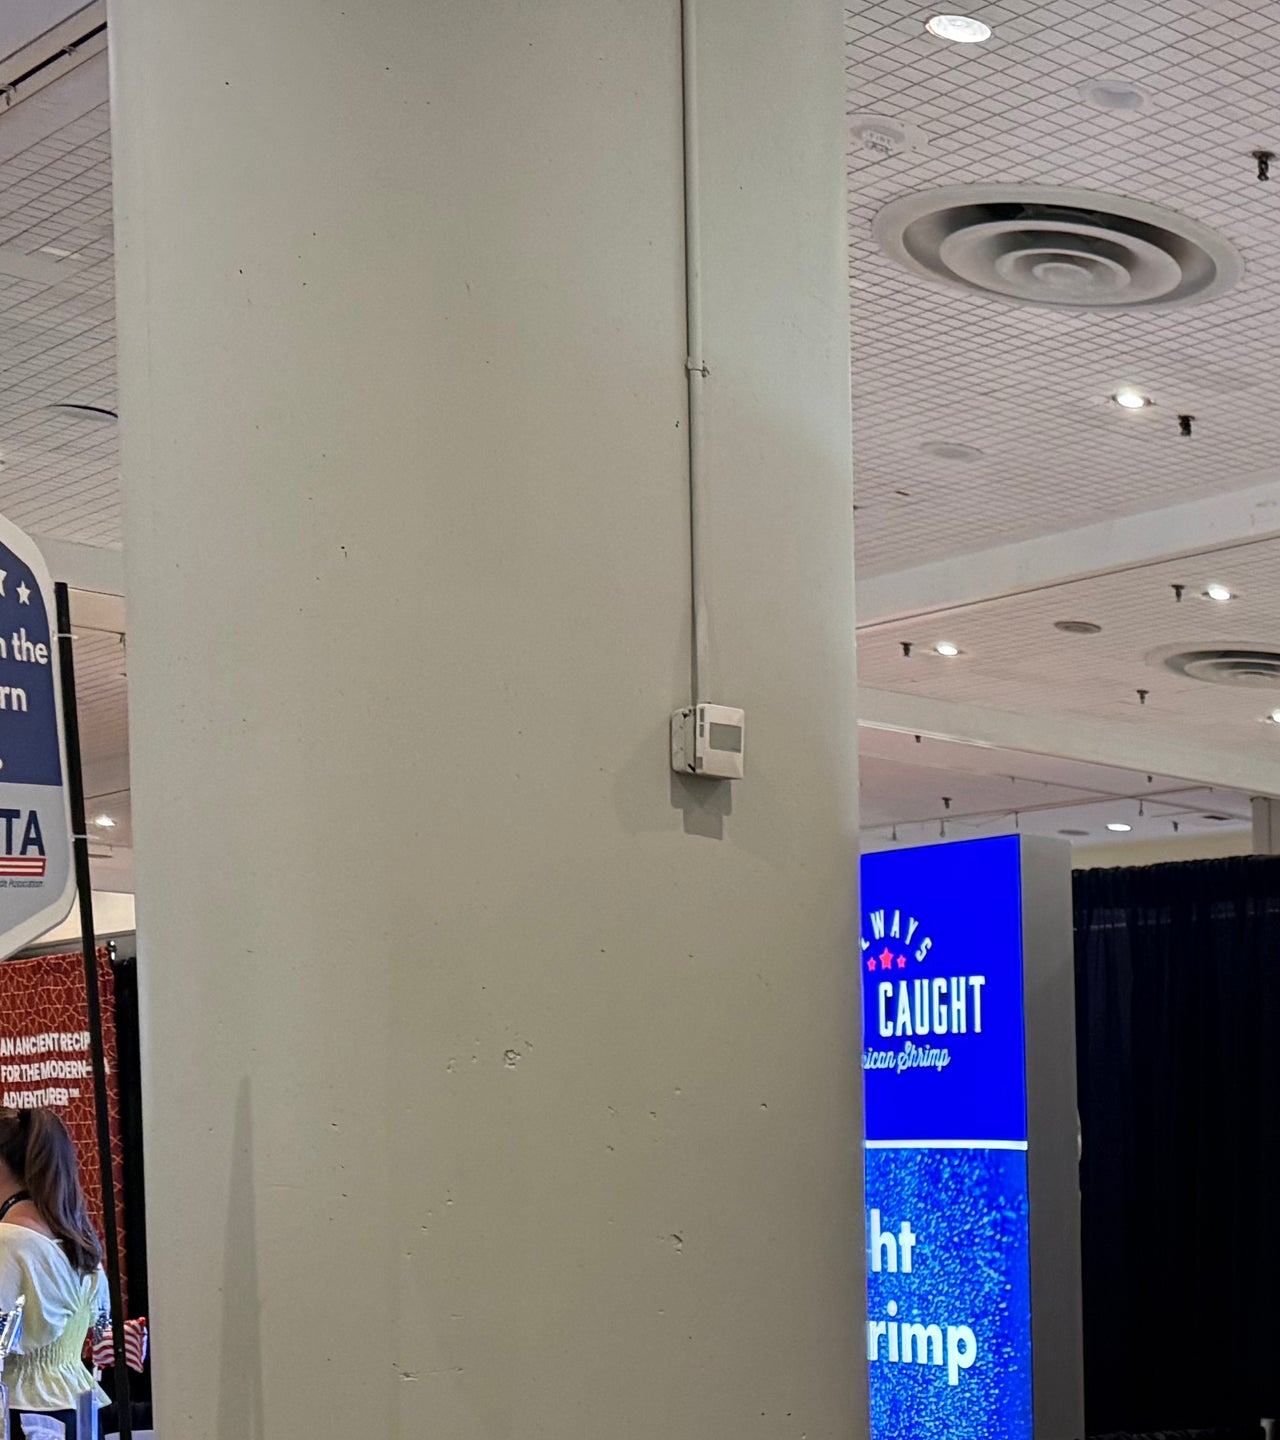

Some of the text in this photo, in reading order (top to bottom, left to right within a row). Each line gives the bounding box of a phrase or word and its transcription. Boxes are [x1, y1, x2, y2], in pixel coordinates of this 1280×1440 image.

[12, 628, 48, 664] the
[878, 975, 985, 1037] CAUGHT
[0, 1031, 91, 1057] AN ANCIENT RECIP
[897, 1041, 950, 1074] Shrimp
[1, 1065, 20, 1083] FOR
[21, 1063, 40, 1082] THE
[871, 1208, 916, 1274] ht
